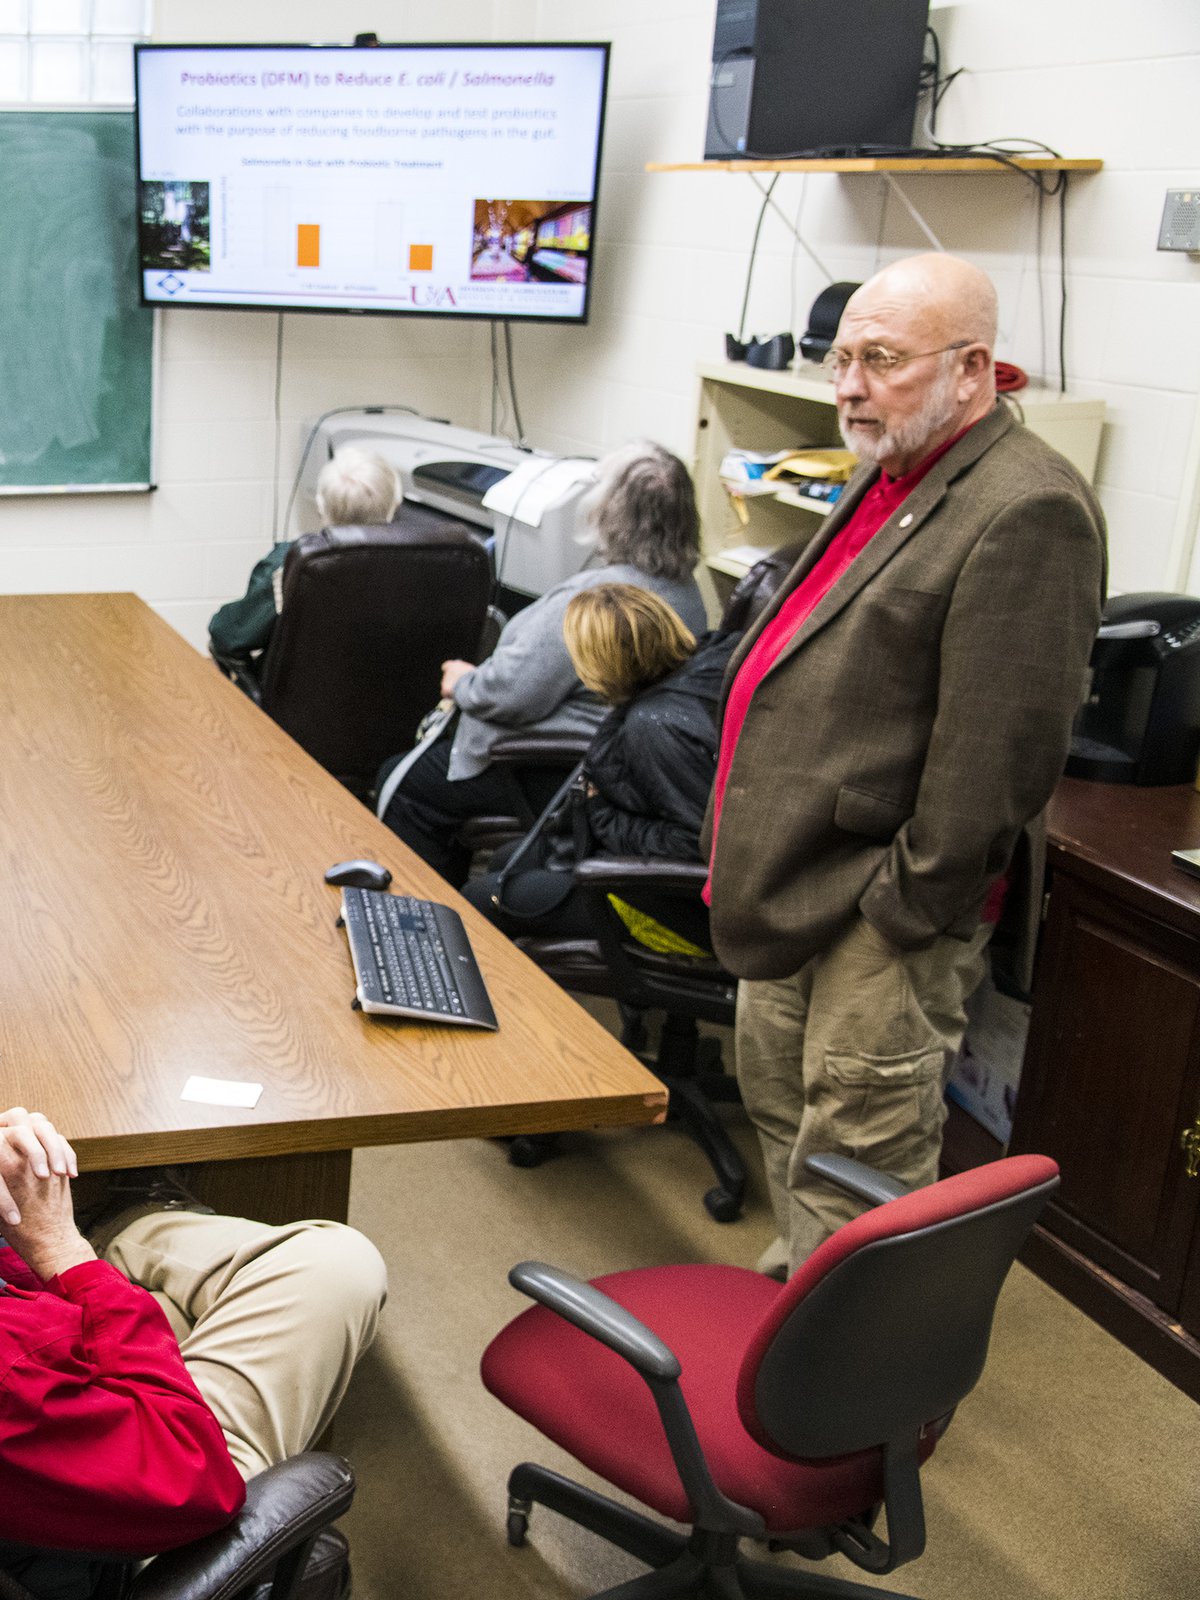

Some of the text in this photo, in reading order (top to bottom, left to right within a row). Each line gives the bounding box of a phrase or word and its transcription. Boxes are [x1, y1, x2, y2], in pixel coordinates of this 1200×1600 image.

[181, 72, 257, 87] Probiotics
[261, 72, 310, 89] (DFM)
[314, 73, 330, 87] to
[335, 72, 392, 87] Reduce
[398, 73, 411, 87] E.
[417, 71, 446, 87] coli
[462, 72, 556, 88] Salmonella
[176, 105, 558, 122] Collaborations with companies to develop and test probiotics
[175, 124, 200, 136] with
[204, 125, 224, 136] the
[227, 126, 276, 139] purpose
[280, 125, 292, 136] of
[296, 125, 349, 139] reducing
[421, 126, 488, 141] pathogens
[491, 127, 503, 138] in
[507, 127, 528, 139] the
